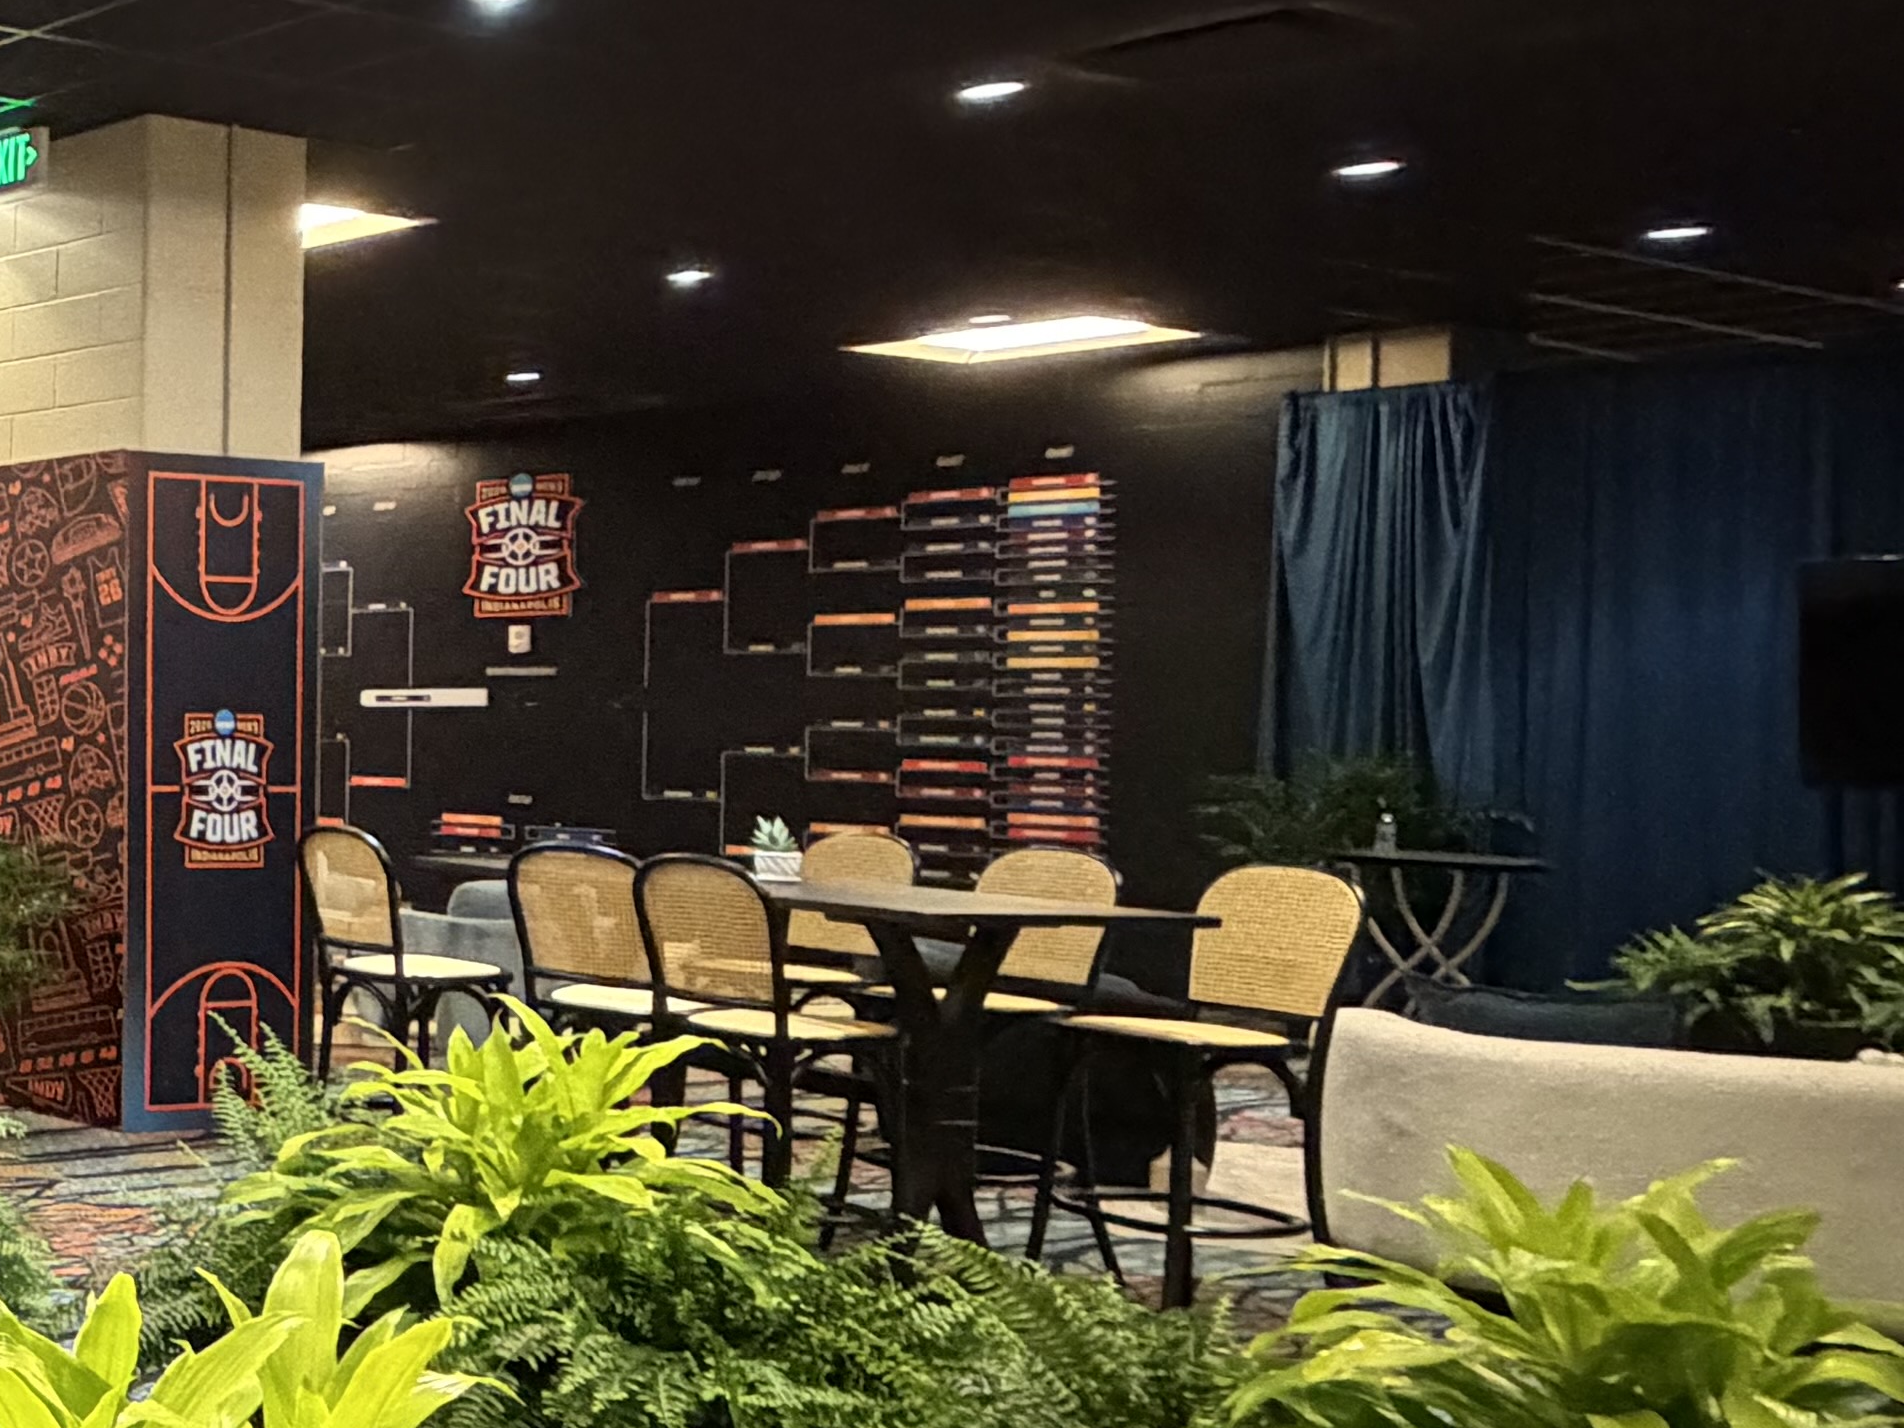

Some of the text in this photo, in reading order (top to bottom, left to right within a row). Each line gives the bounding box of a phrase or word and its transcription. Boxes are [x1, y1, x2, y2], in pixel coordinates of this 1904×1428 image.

[478, 498, 563, 534] FINAL
[479, 561, 561, 594] FOUR
[186, 738, 259, 773] FINAL
[190, 809, 259, 844] FOUR
